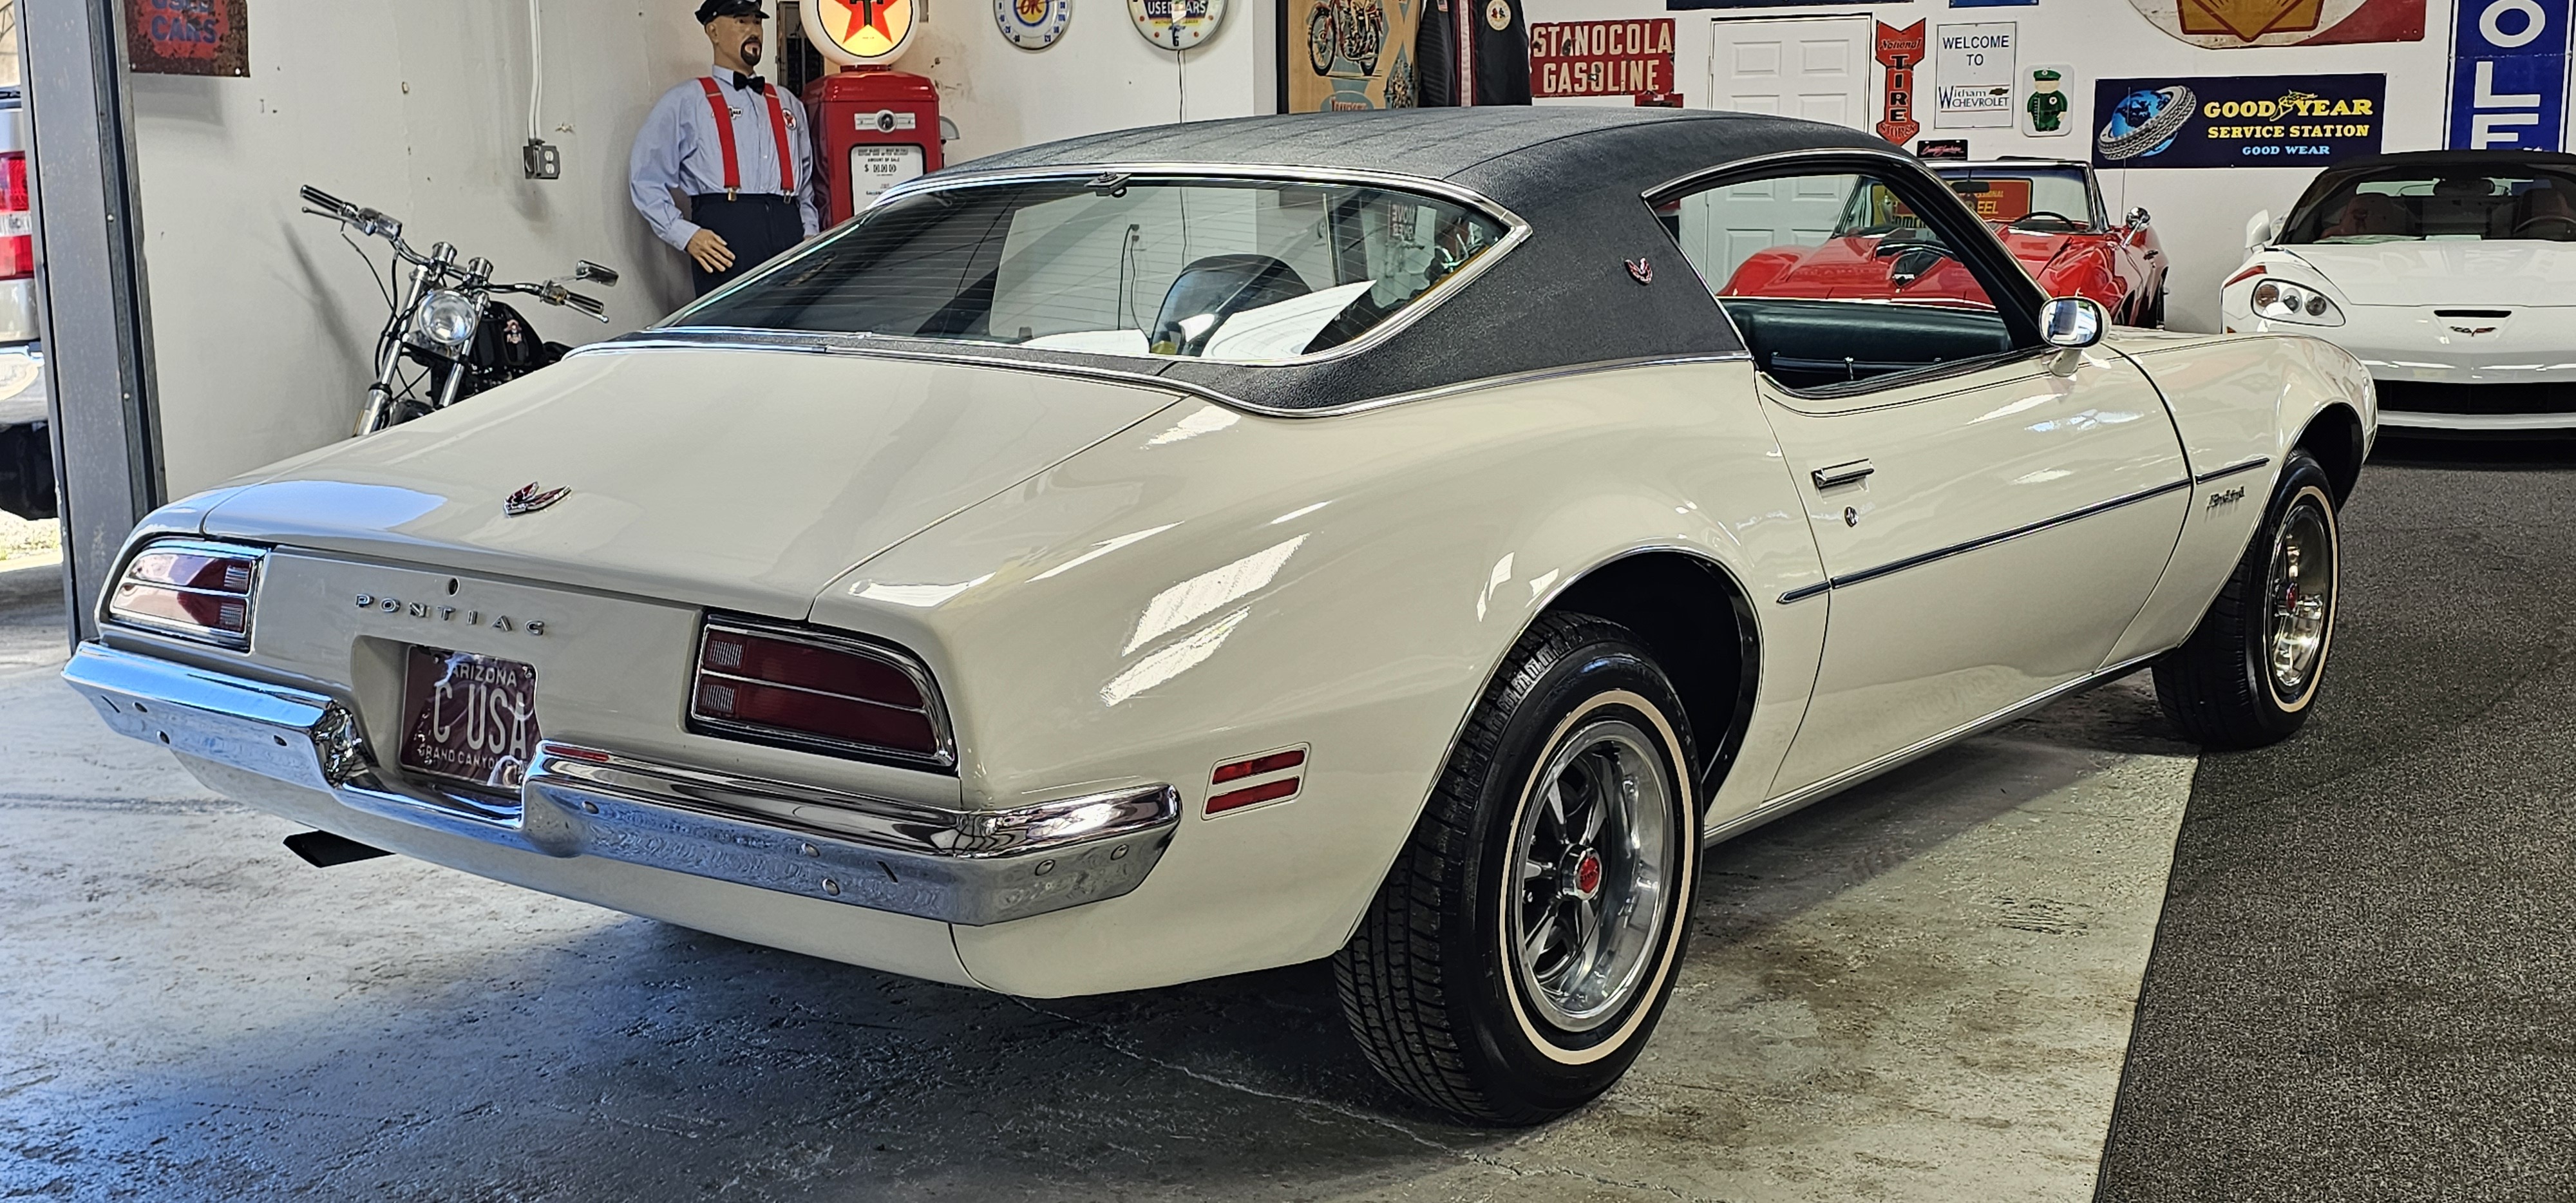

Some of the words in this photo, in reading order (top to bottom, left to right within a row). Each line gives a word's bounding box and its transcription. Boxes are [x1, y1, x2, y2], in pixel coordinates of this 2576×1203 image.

[1186, 1, 1206, 14] ARS
[151, 15, 216, 43] CARS
[1533, 23, 1672, 57] STANOCOLA
[1880, 37, 1922, 51] National
[1943, 35, 2009, 49] WELCOME
[1967, 53, 1984, 66] TO
[1543, 59, 1660, 93] GASOLINE
[1889, 54, 1909, 122] TIRE
[1952, 97, 2010, 108] CHEVROLET
[1880, 122, 1917, 140] STORES
[2208, 126, 2285, 138] SERVICE
[2289, 125, 2370, 137] STATION
[2242, 146, 2280, 155] GOOD
[2286, 146, 2330, 155] WEAR
[355, 594, 545, 636] PONTIAC
[452, 663, 517, 687] ARIZONA
[433, 682, 453, 743] C
[467, 684, 527, 759] USA
[419, 743, 455, 763] GRAND
[457, 751, 497, 770] CANYO
